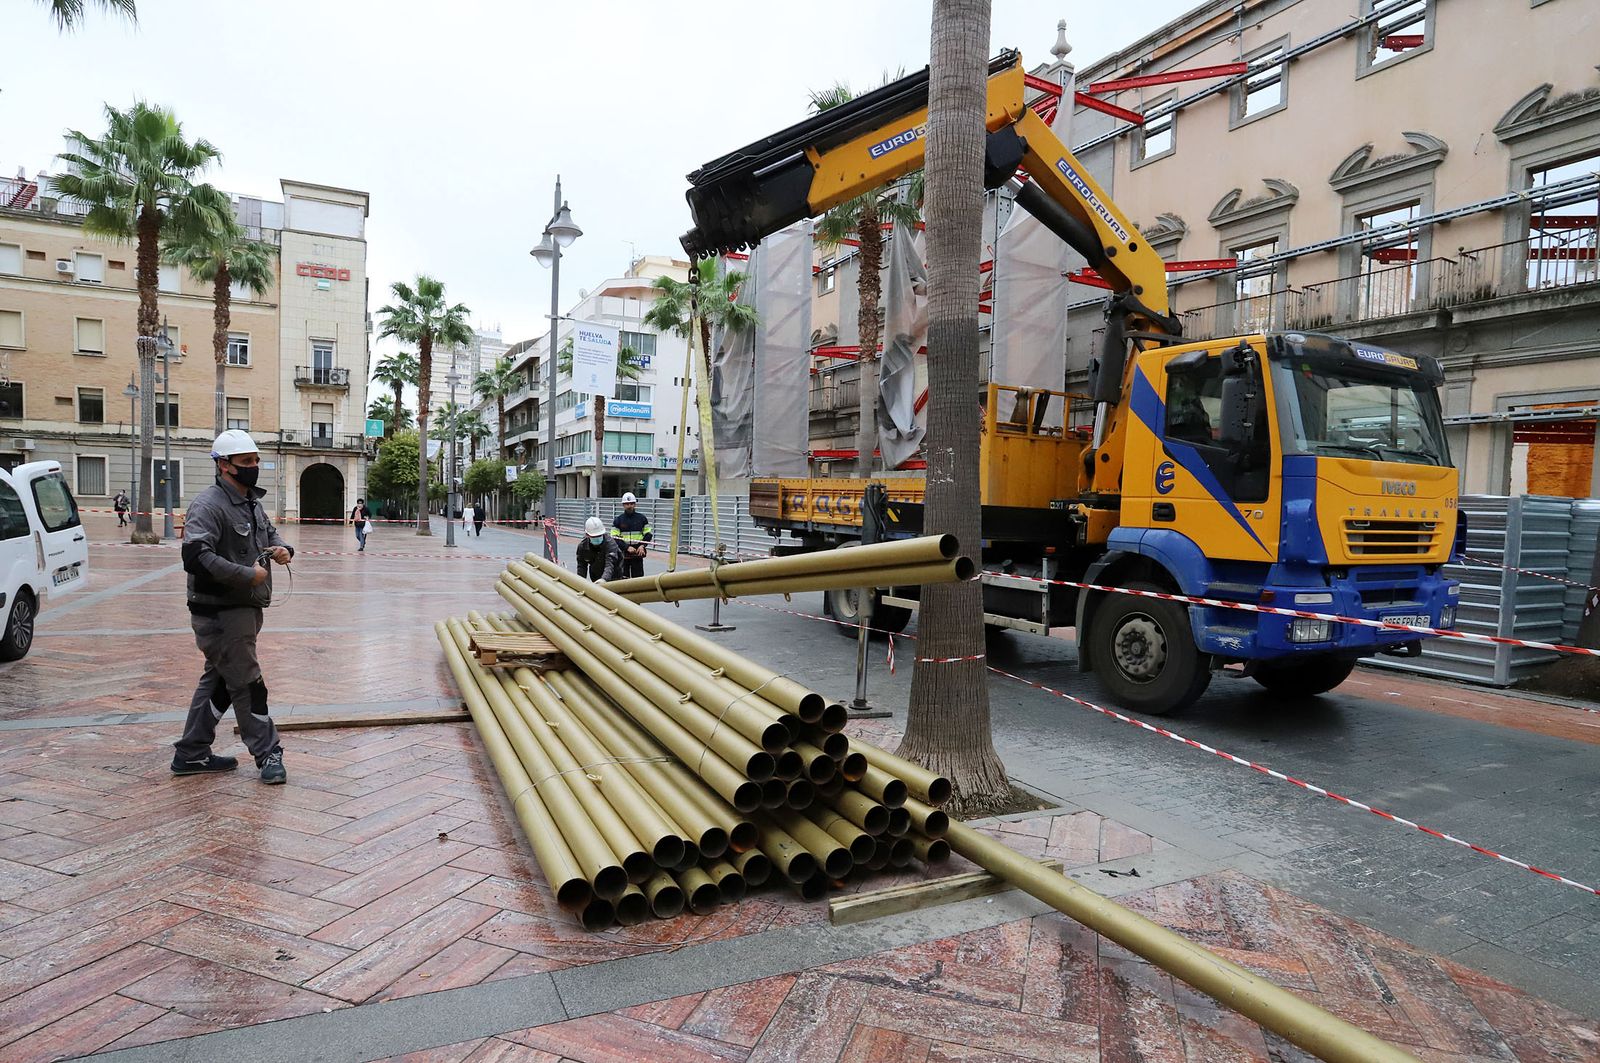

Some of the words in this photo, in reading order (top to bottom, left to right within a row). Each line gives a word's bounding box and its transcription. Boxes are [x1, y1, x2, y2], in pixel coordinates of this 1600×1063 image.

[871, 124, 928, 157] EUROG
[1058, 160, 1128, 241] EUROGRUAS
[579, 330, 603, 339] HUELVA
[610, 404, 650, 415] mediolanum
[611, 454, 653, 462] PREVENTIVA
[1382, 480, 1417, 495] IVECO
